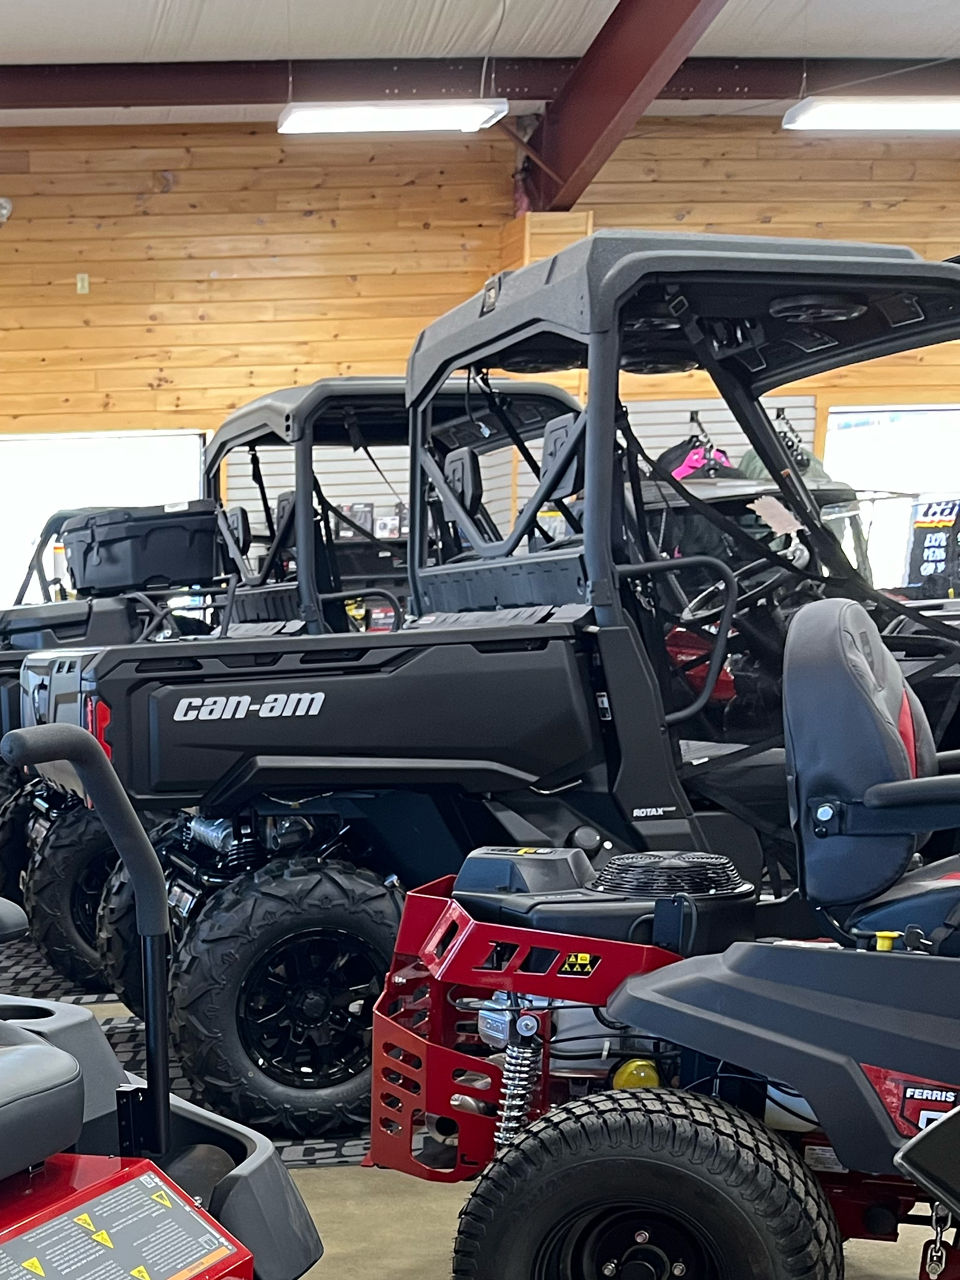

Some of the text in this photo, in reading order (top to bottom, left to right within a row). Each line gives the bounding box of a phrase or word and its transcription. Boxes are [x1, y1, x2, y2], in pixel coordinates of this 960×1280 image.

[173, 692, 325, 721] can-am
[633, 808, 664, 817] ROTAX
[905, 1087, 956, 1102] FERRIS
